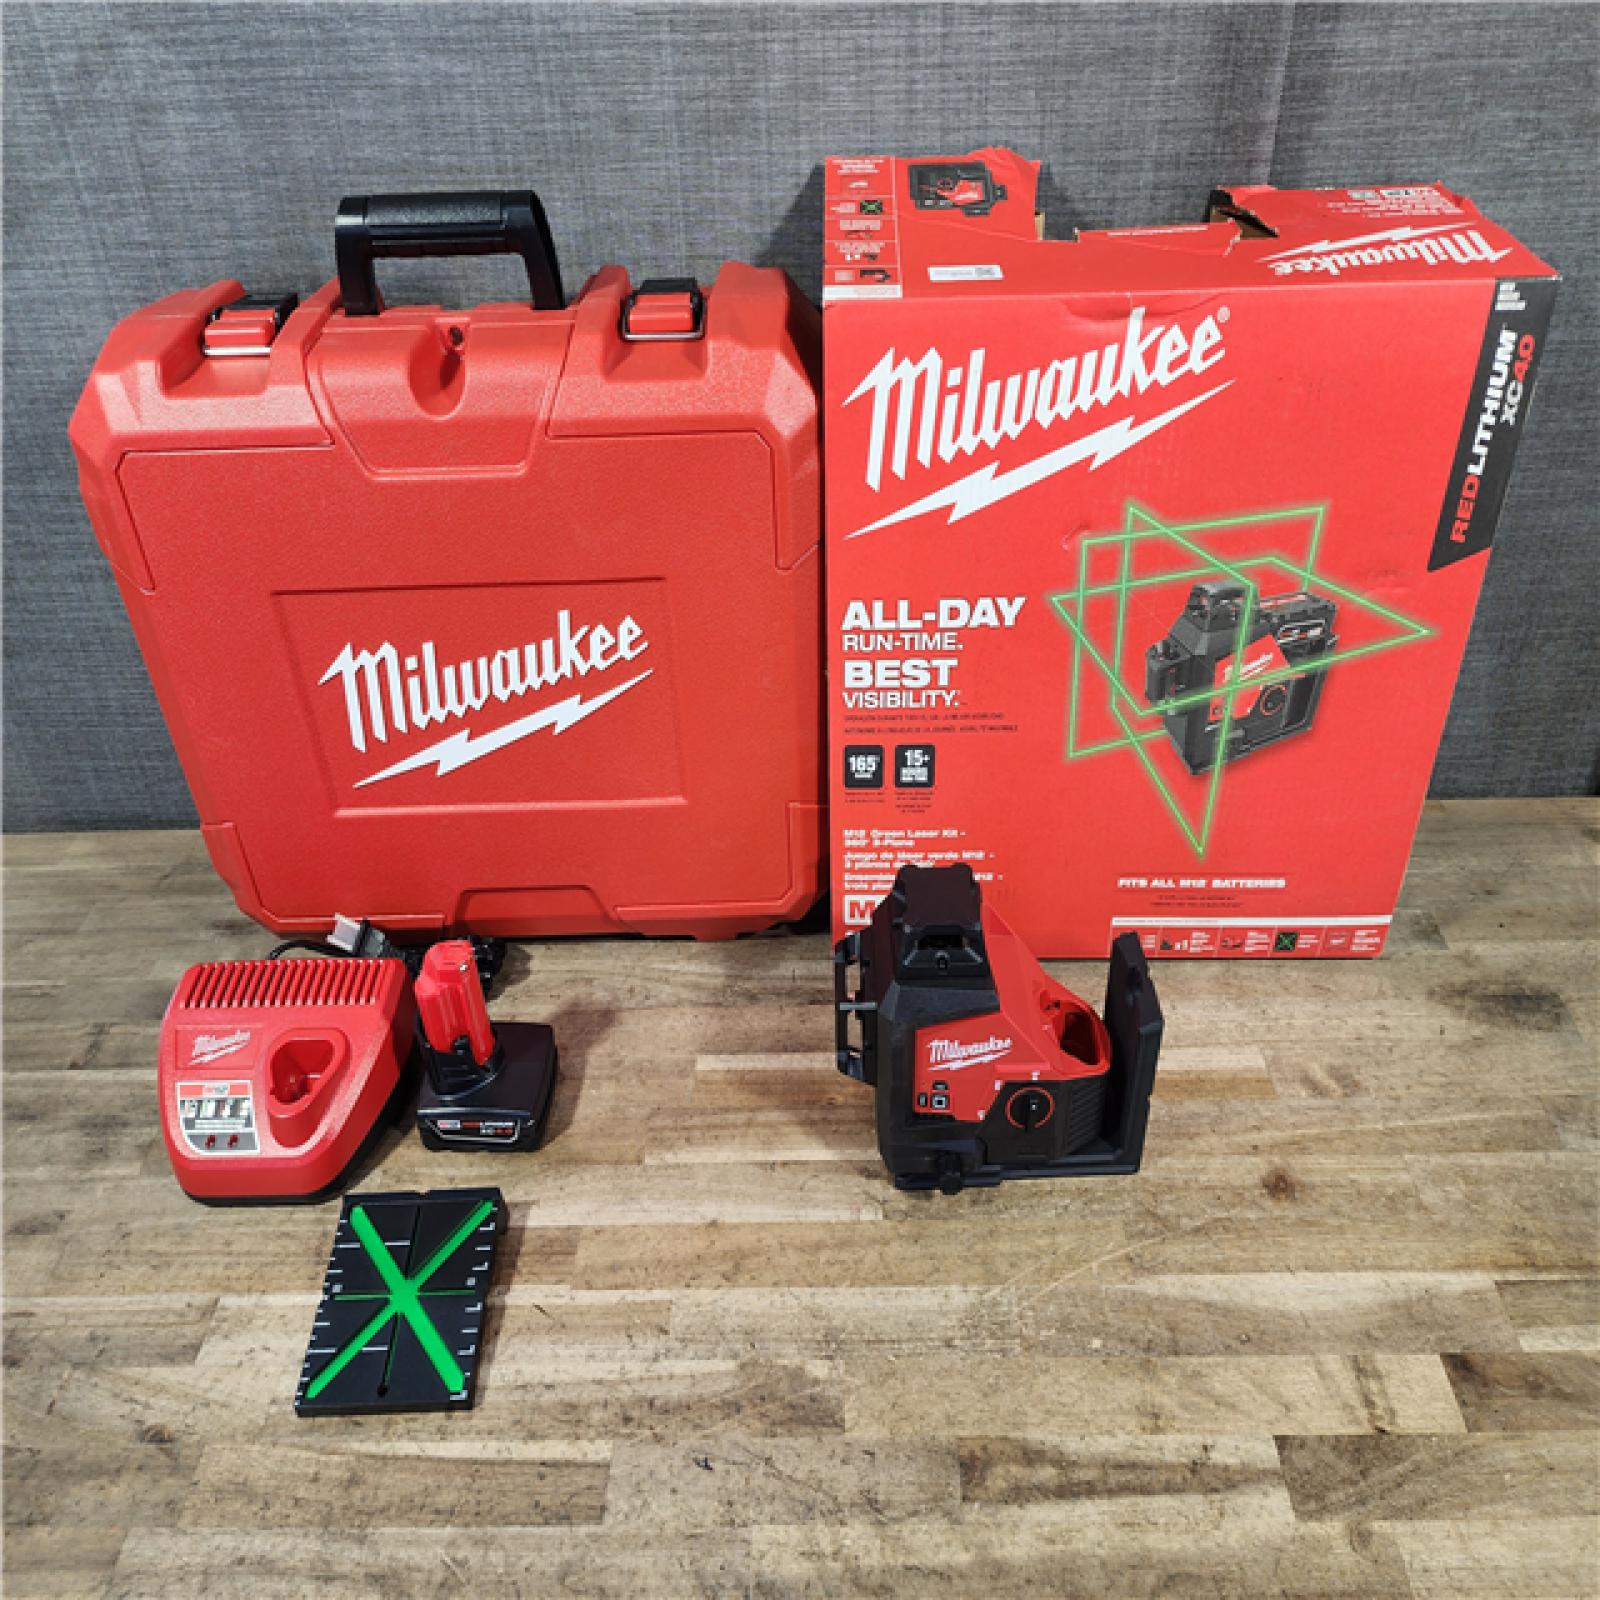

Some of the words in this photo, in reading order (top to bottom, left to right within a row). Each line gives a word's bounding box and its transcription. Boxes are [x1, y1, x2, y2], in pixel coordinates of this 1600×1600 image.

[1268, 230, 1513, 275] Milwaukee
[842, 597, 1025, 630] ALL-DAY
[843, 632, 963, 651] RUN-TIME.
[318, 609, 649, 753] Milwaukee
[844, 658, 958, 688] BEST
[1212, 878, 1286, 888] BATTERIES
